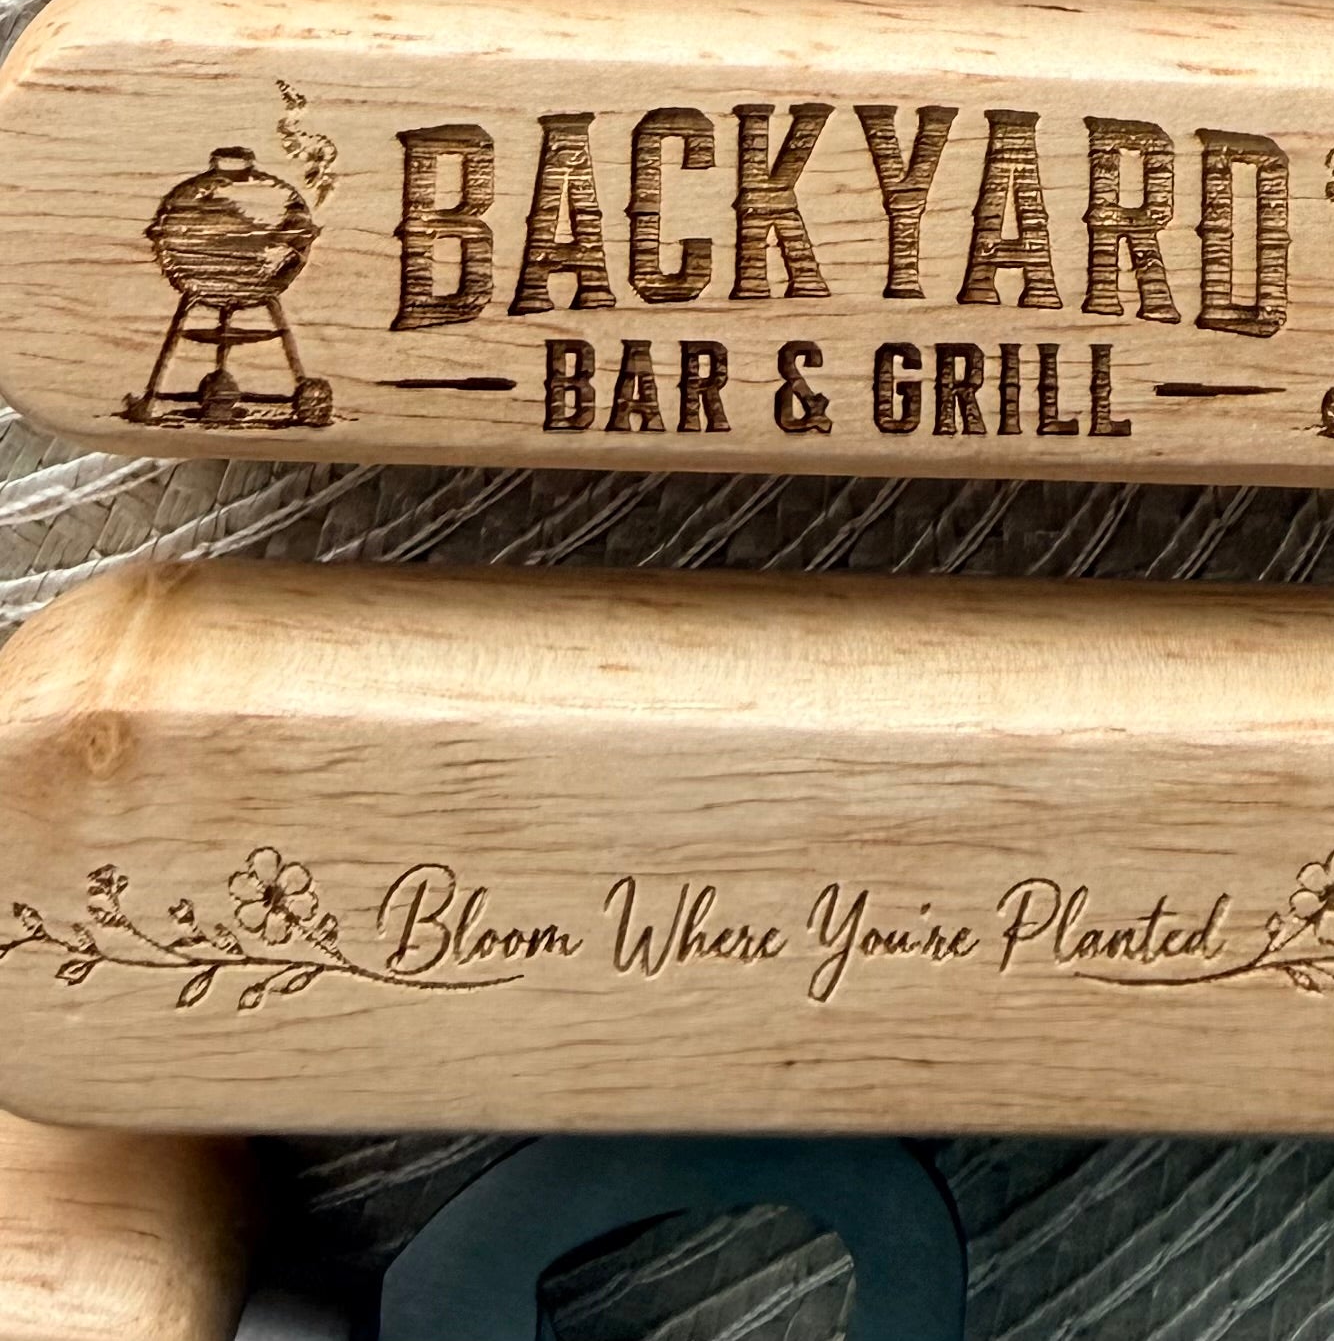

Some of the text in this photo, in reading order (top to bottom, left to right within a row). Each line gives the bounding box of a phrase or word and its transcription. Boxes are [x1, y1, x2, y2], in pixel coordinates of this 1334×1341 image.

[389, 103, 1293, 338] BACKYARD
[543, 337, 1134, 438] BAR & GRILL
[375, 862, 1232, 1004] Bloom Where You're Planted
